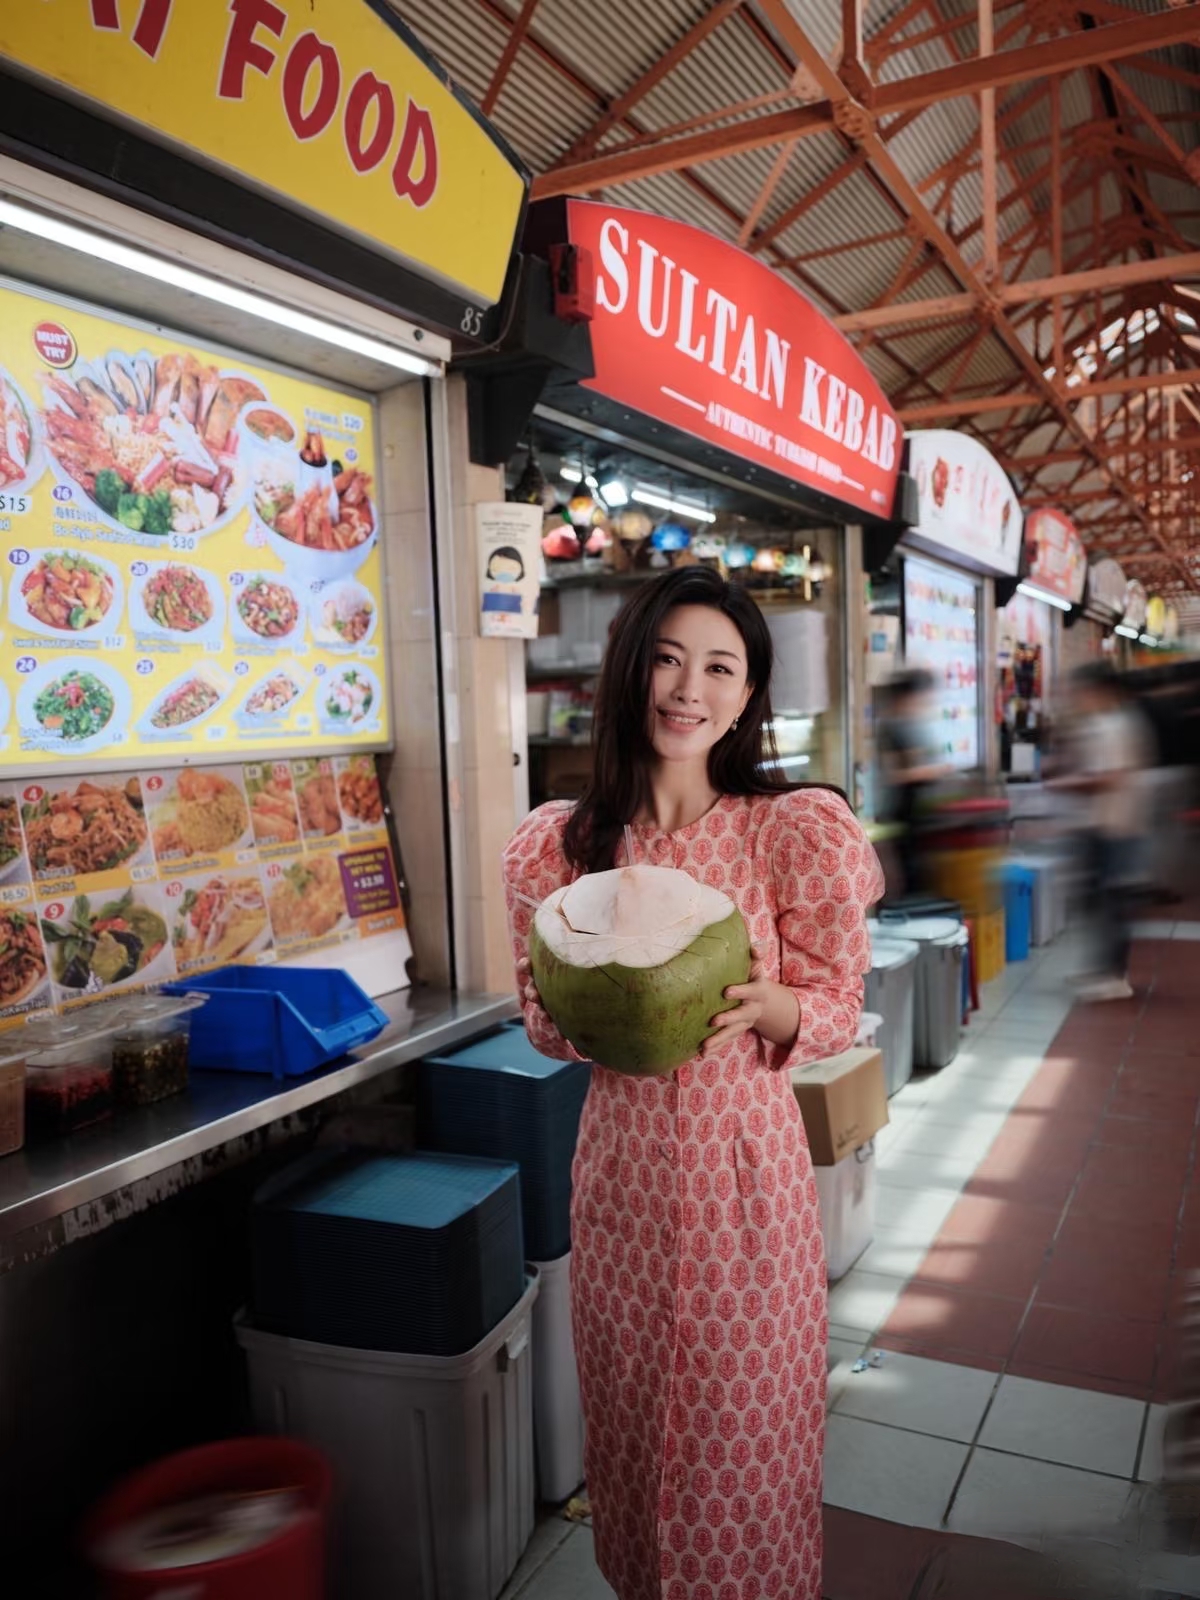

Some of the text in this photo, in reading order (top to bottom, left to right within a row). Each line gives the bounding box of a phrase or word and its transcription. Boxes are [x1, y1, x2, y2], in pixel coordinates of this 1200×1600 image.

[216, 0, 439, 211] FOOD
[460, 306, 484, 336] 85
[36, 330, 69, 346] MUST
[595, 217, 897, 472] SULTAN KEBAB
[42, 345, 66, 360] TRY
[55, 486, 71, 499] 16
[173, 534, 195, 550] $30
[12, 551, 28, 564] 19
[28, 787, 38, 800] 4
[50, 905, 59, 918] 9
